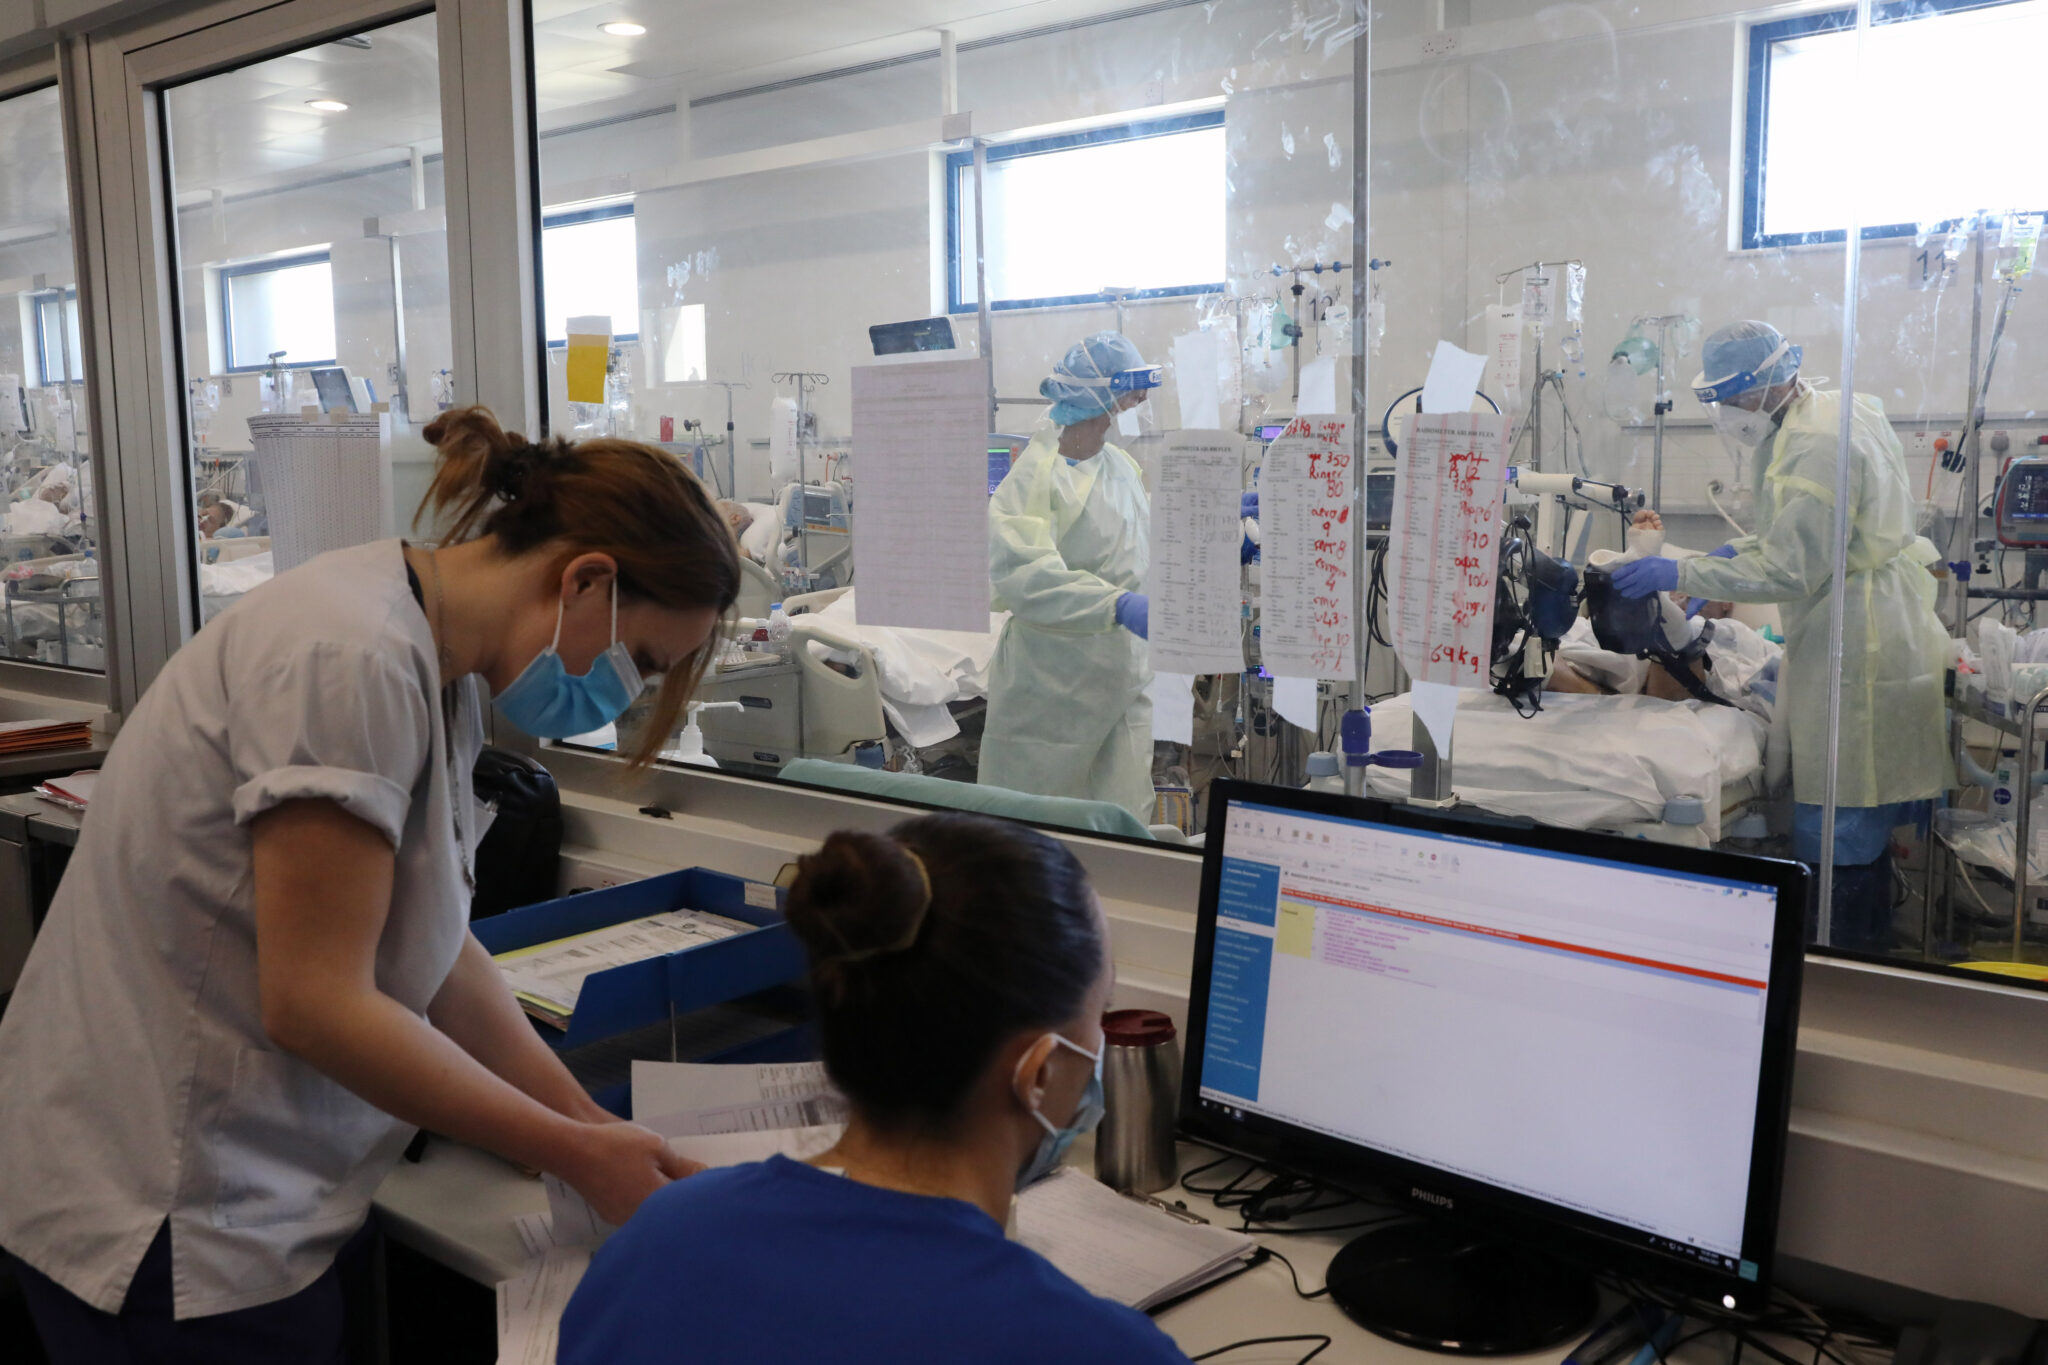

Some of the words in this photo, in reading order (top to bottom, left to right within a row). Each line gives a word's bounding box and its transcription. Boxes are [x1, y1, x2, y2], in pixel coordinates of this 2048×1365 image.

[1917, 249, 1945, 281] 11
[1309, 295, 1333, 321] 12
[1412, 1187, 1453, 1209] PHILIPS
